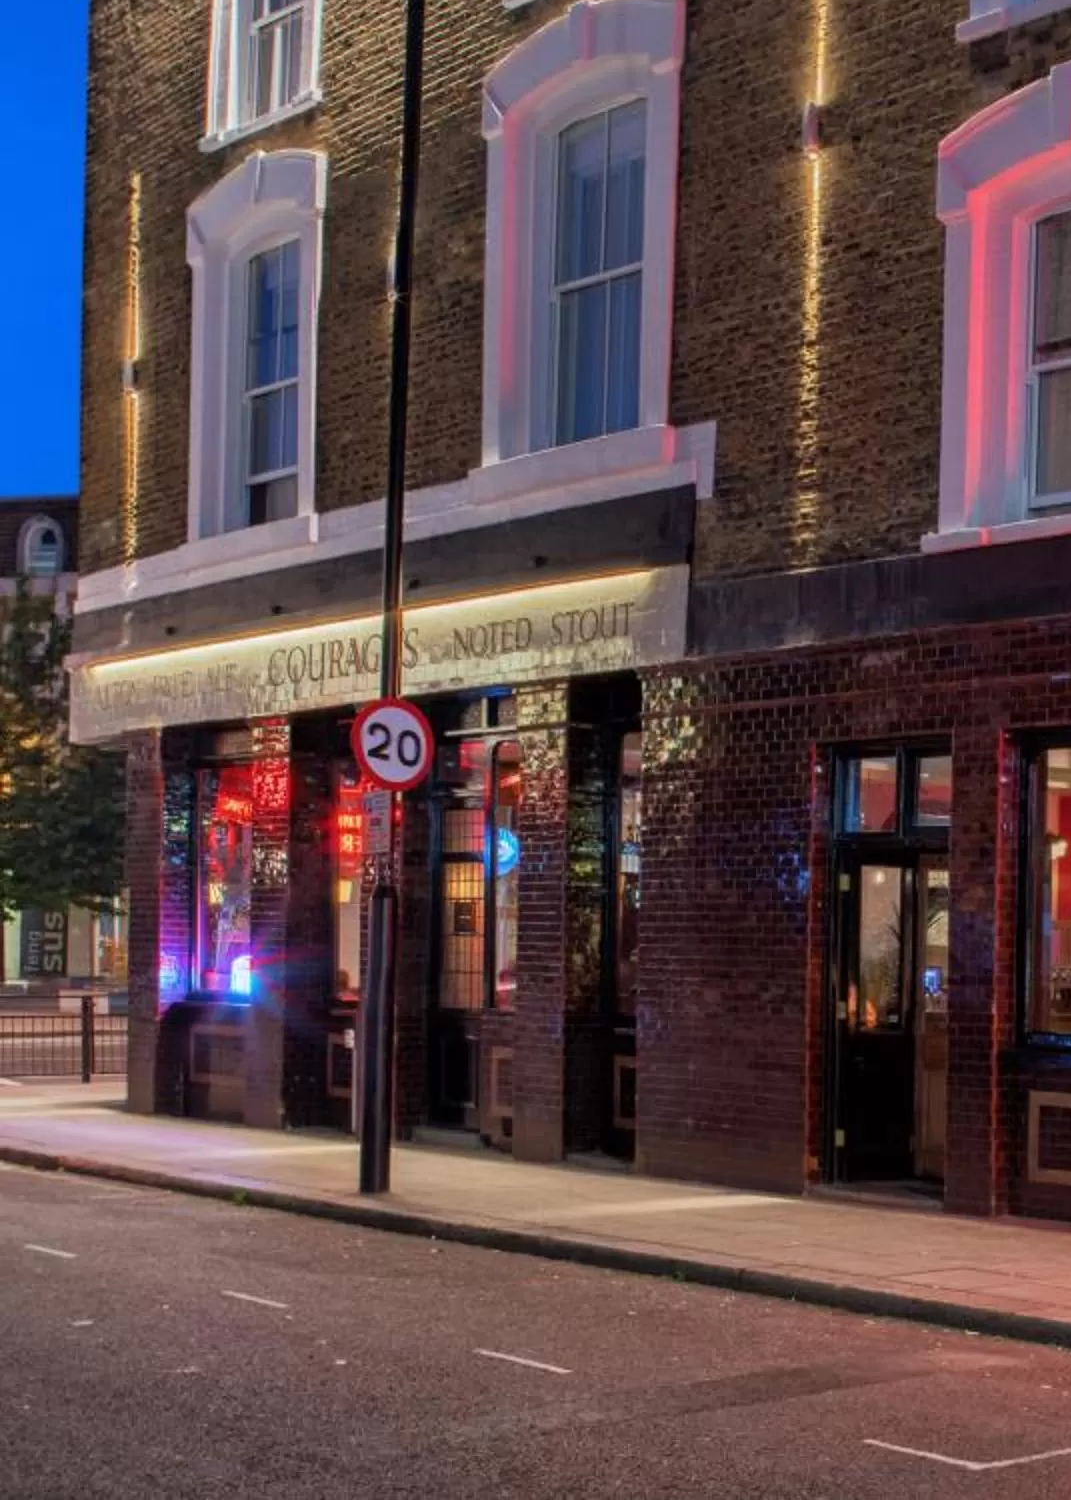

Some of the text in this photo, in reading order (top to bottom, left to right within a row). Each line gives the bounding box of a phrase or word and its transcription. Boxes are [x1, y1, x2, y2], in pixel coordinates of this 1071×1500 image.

[452, 616, 533, 661] NOTED
[550, 602, 635, 646] STOUT
[367, 721, 422, 768] 20
